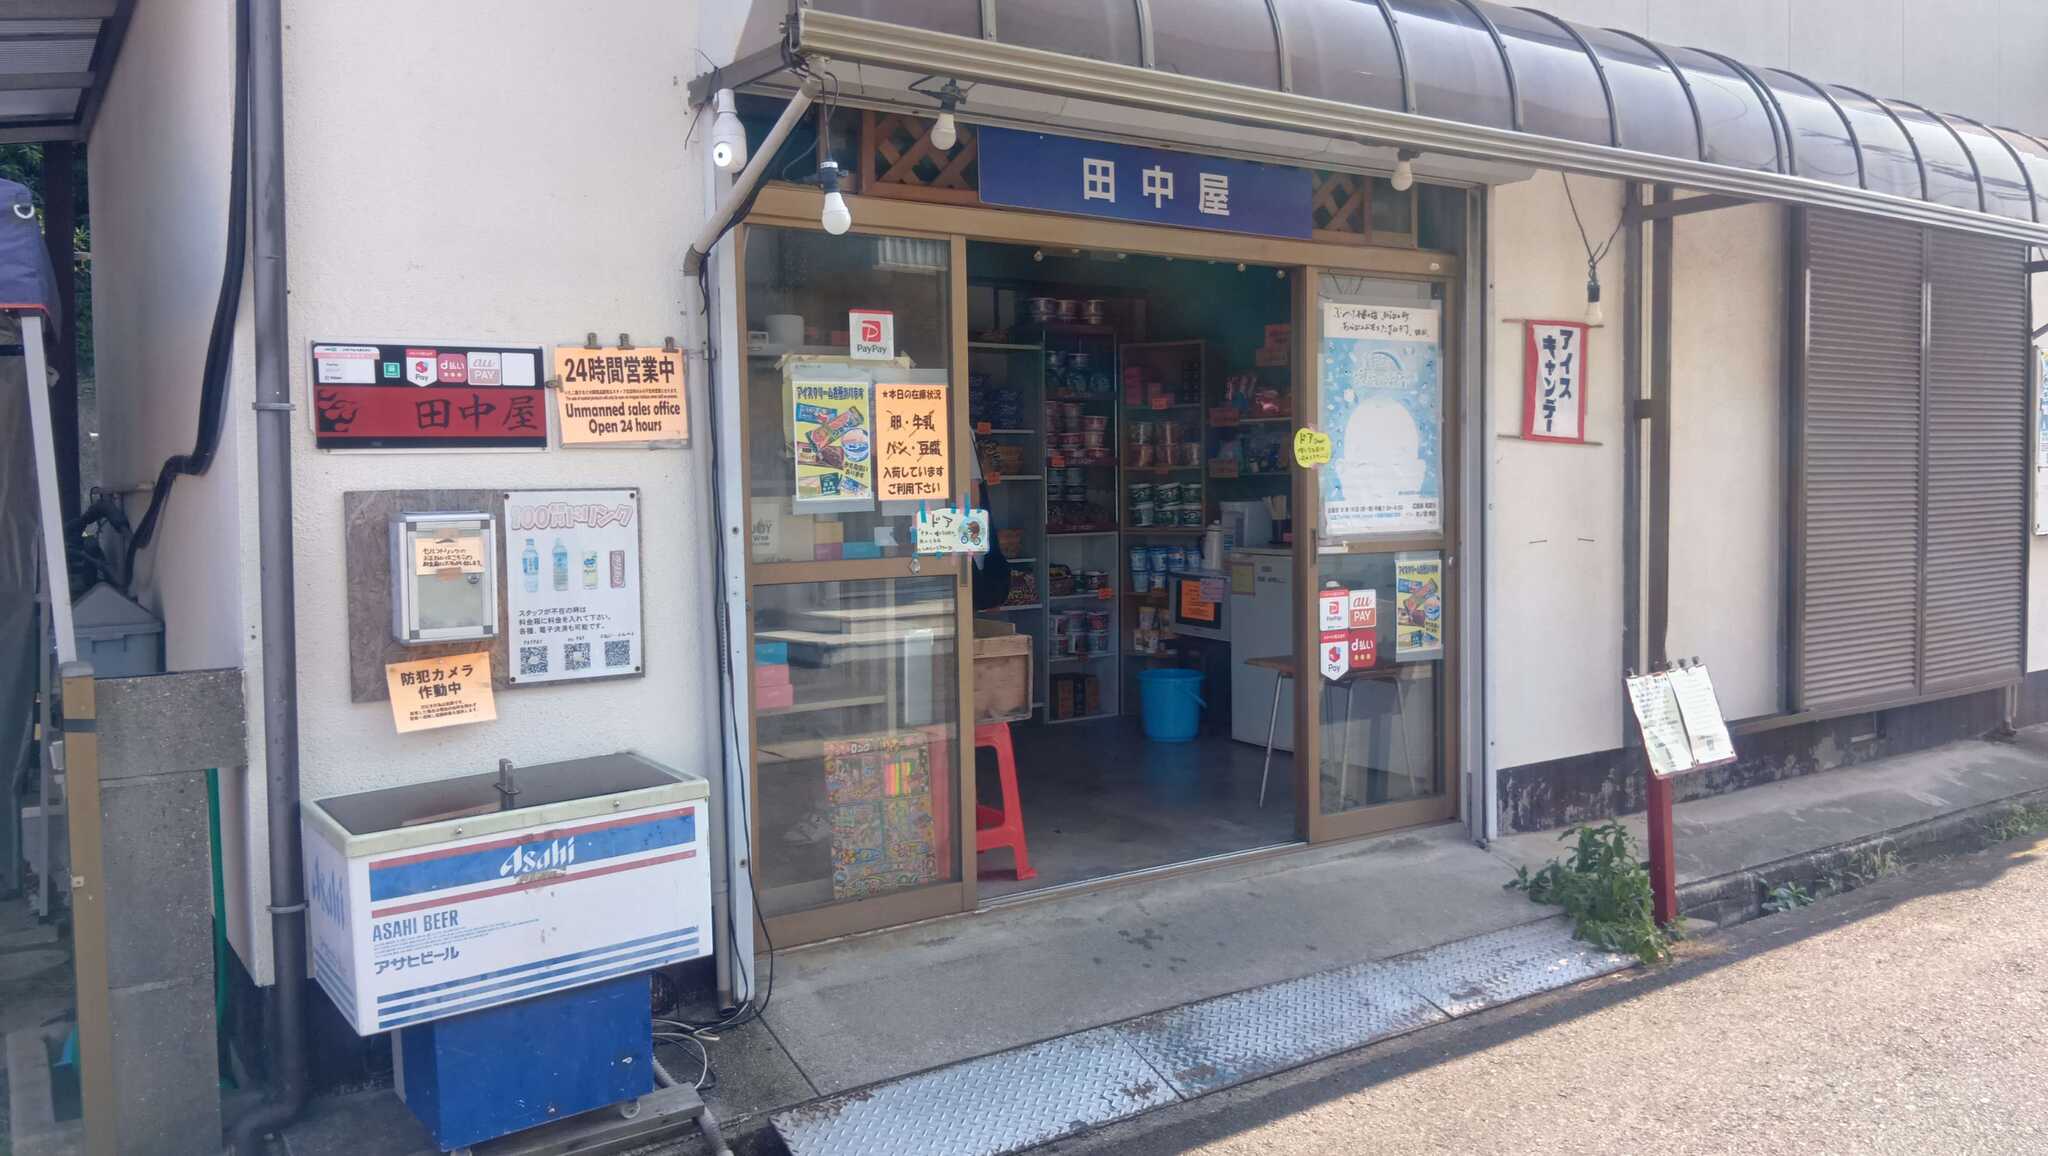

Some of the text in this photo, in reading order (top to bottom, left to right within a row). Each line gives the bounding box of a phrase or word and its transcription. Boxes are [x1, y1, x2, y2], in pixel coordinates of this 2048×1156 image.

[1083, 157, 1230, 216] 田中屋
[857, 343, 887, 354] PayPay
[564, 355, 675, 384] 24時間営業中
[1559, 329, 1574, 399] アイス
[474, 370, 496, 380] PAY
[415, 393, 538, 431] 田中屋
[565, 400, 681, 418] Unmanned sales office
[588, 417, 662, 436] Open 24 hours
[883, 466, 944, 479] 入荷しています
[888, 482, 940, 495] ご利用下さい
[932, 513, 953, 528] ドア
[1353, 596, 1372, 608] au
[519, 606, 587, 617] スタッフが不在の時は
[1353, 610, 1372, 622] PAY
[400, 664, 474, 687] 防犯カメラ
[1327, 663, 1341, 673] Pay
[418, 681, 461, 700] 作動中
[500, 836, 575, 876] Asahi
[372, 917, 417, 942] ASAHI
[423, 909, 459, 932] BEER
[374, 946, 460, 975] アサヒビール
